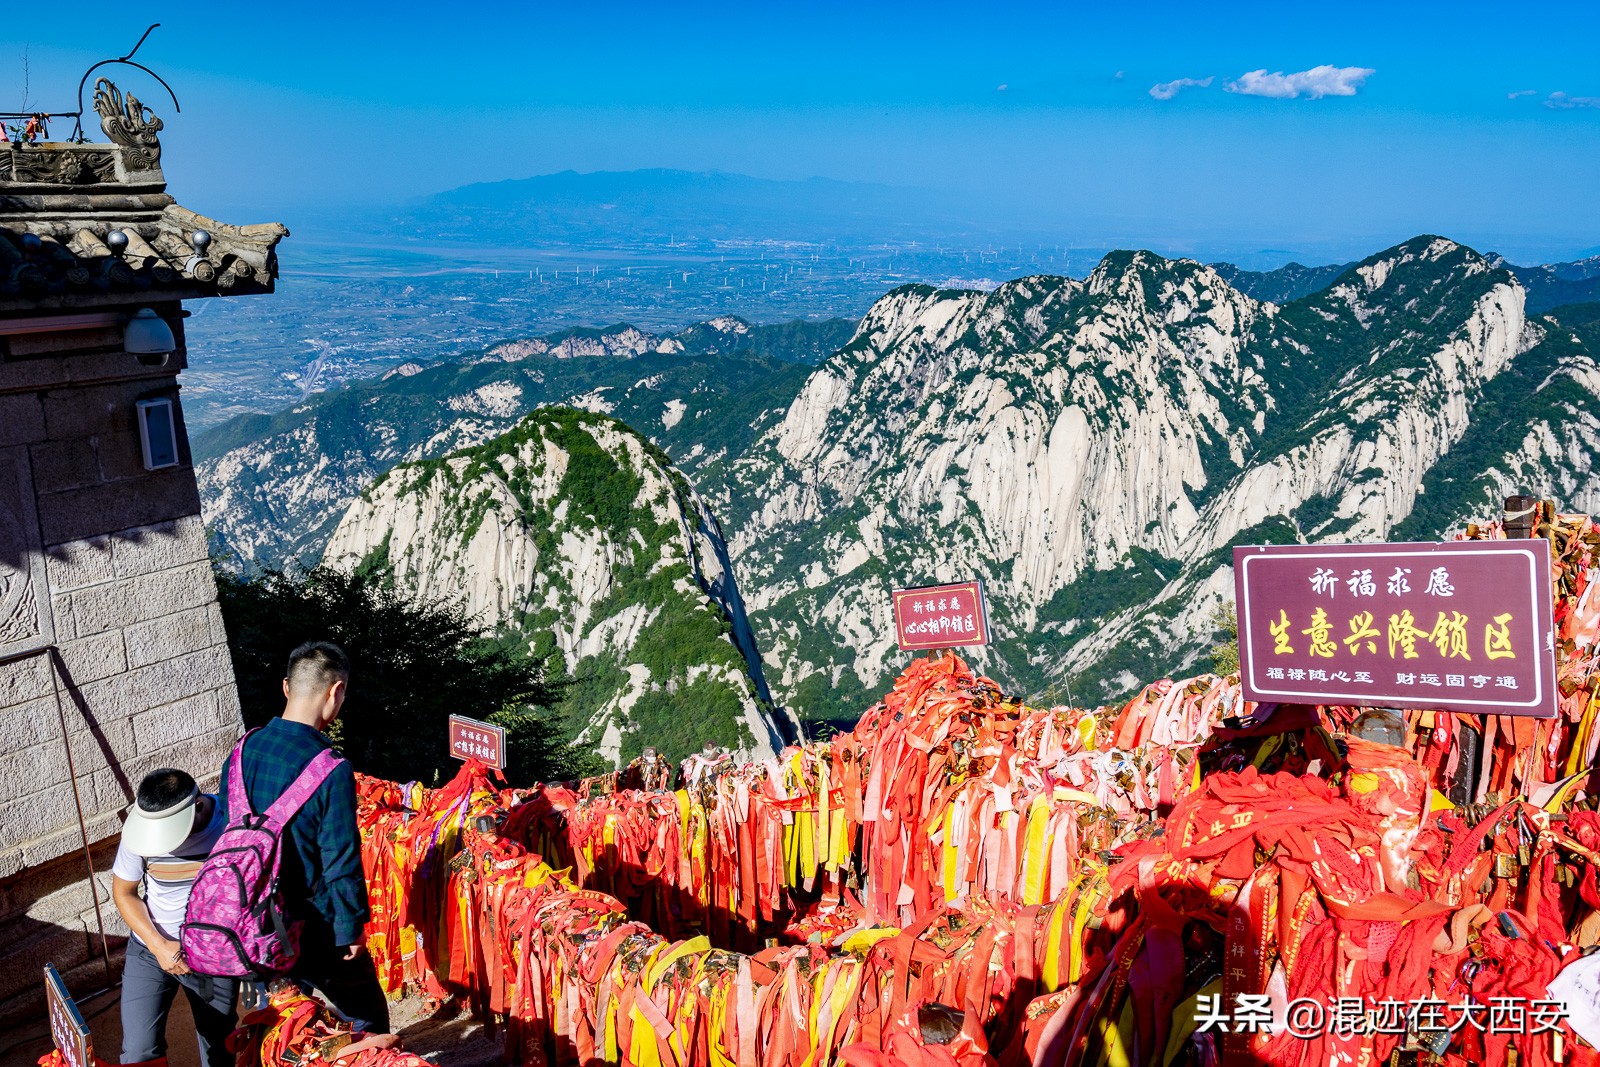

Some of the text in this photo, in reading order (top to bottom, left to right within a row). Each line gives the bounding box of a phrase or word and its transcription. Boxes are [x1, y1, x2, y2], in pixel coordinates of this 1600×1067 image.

[1308, 566, 1456, 599] 祈福求愿
[905, 613, 975, 636] 心心相印锁区
[1269, 607, 1517, 661] 生意兴隆锁区
[1265, 666, 1374, 684] 福禄随心至
